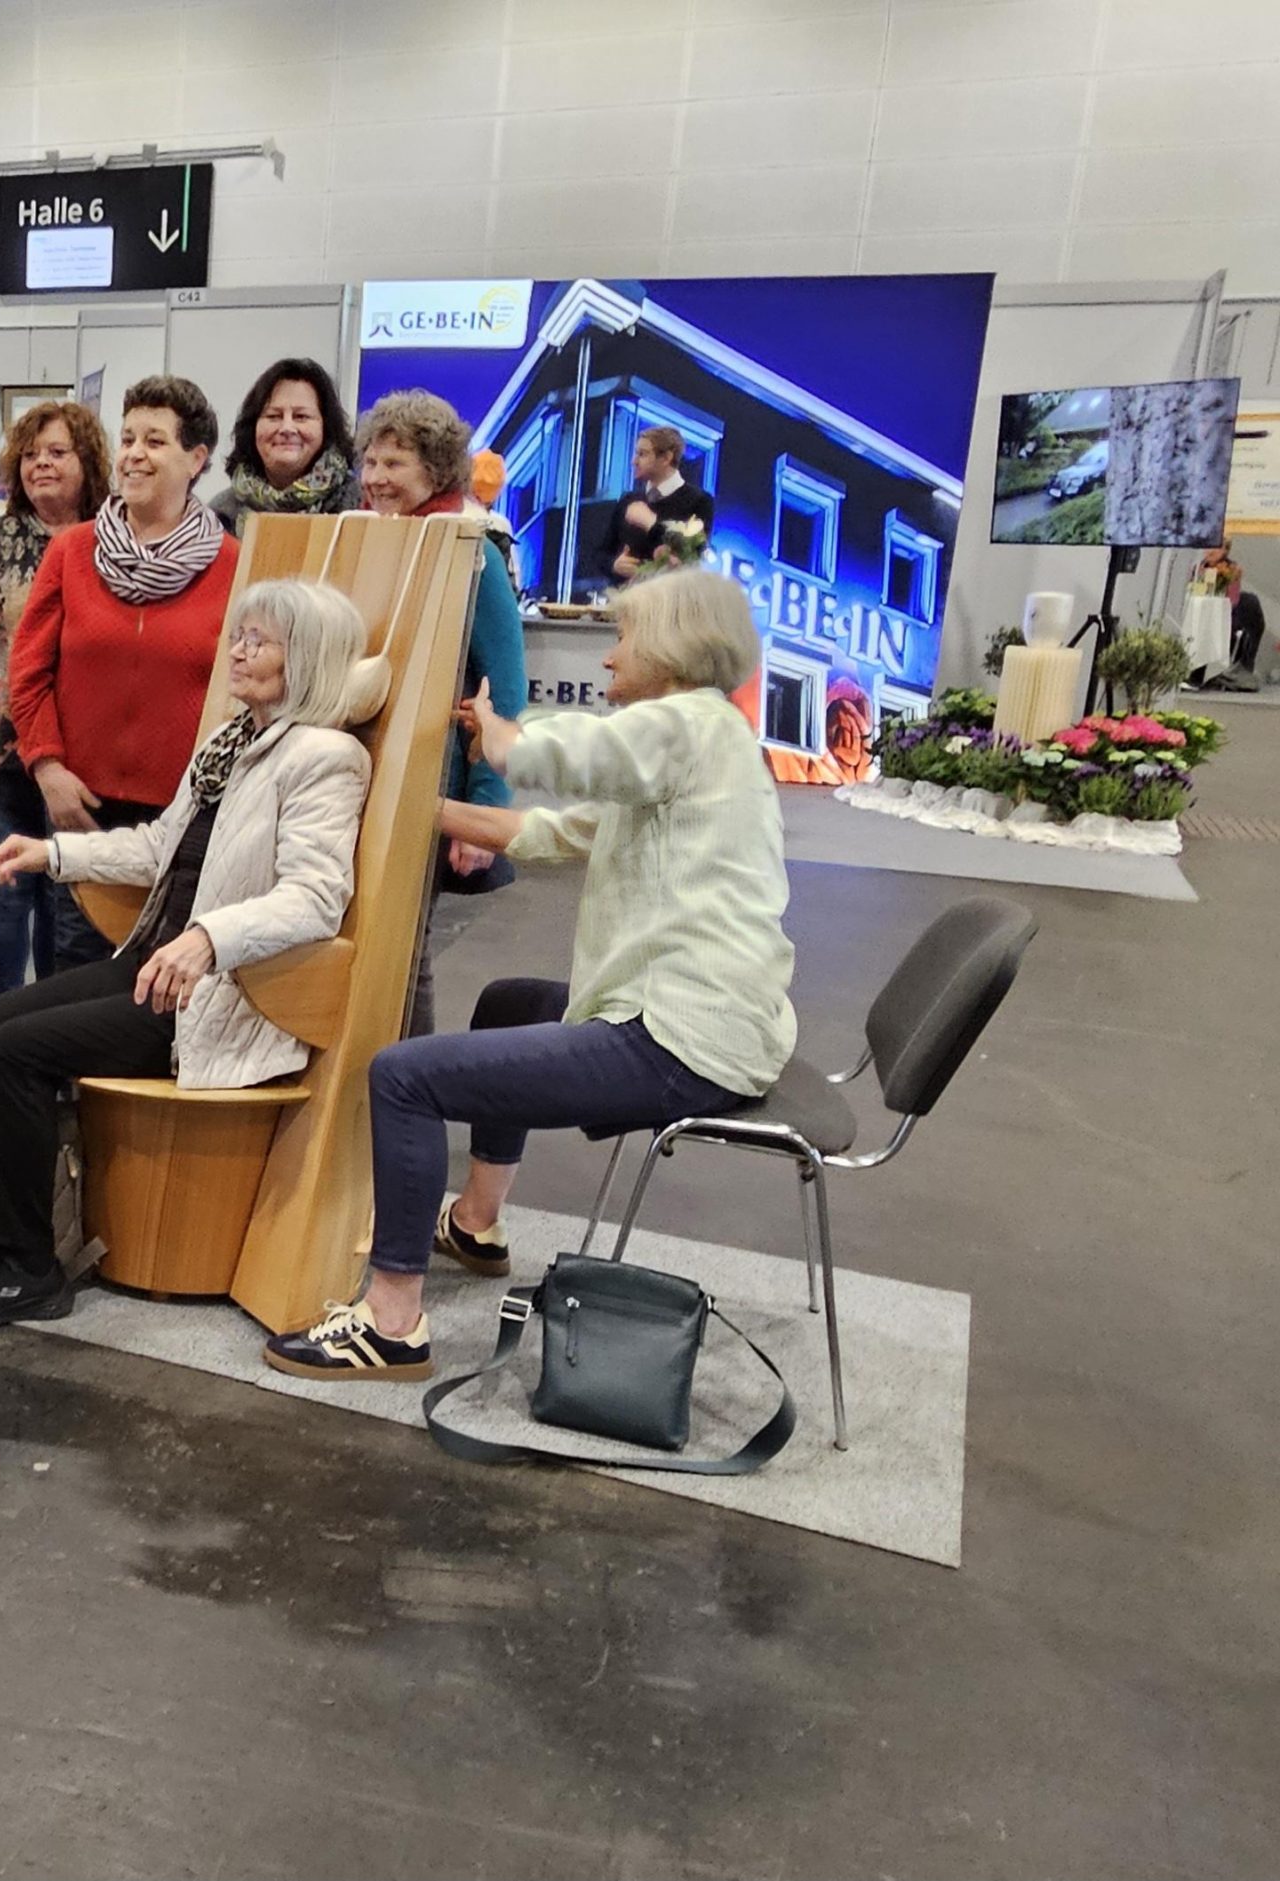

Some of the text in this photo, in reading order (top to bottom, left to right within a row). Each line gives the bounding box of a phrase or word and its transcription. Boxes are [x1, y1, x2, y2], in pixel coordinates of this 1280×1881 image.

[18, 196, 104, 227] Halle 6
[177, 291, 201, 303] C42
